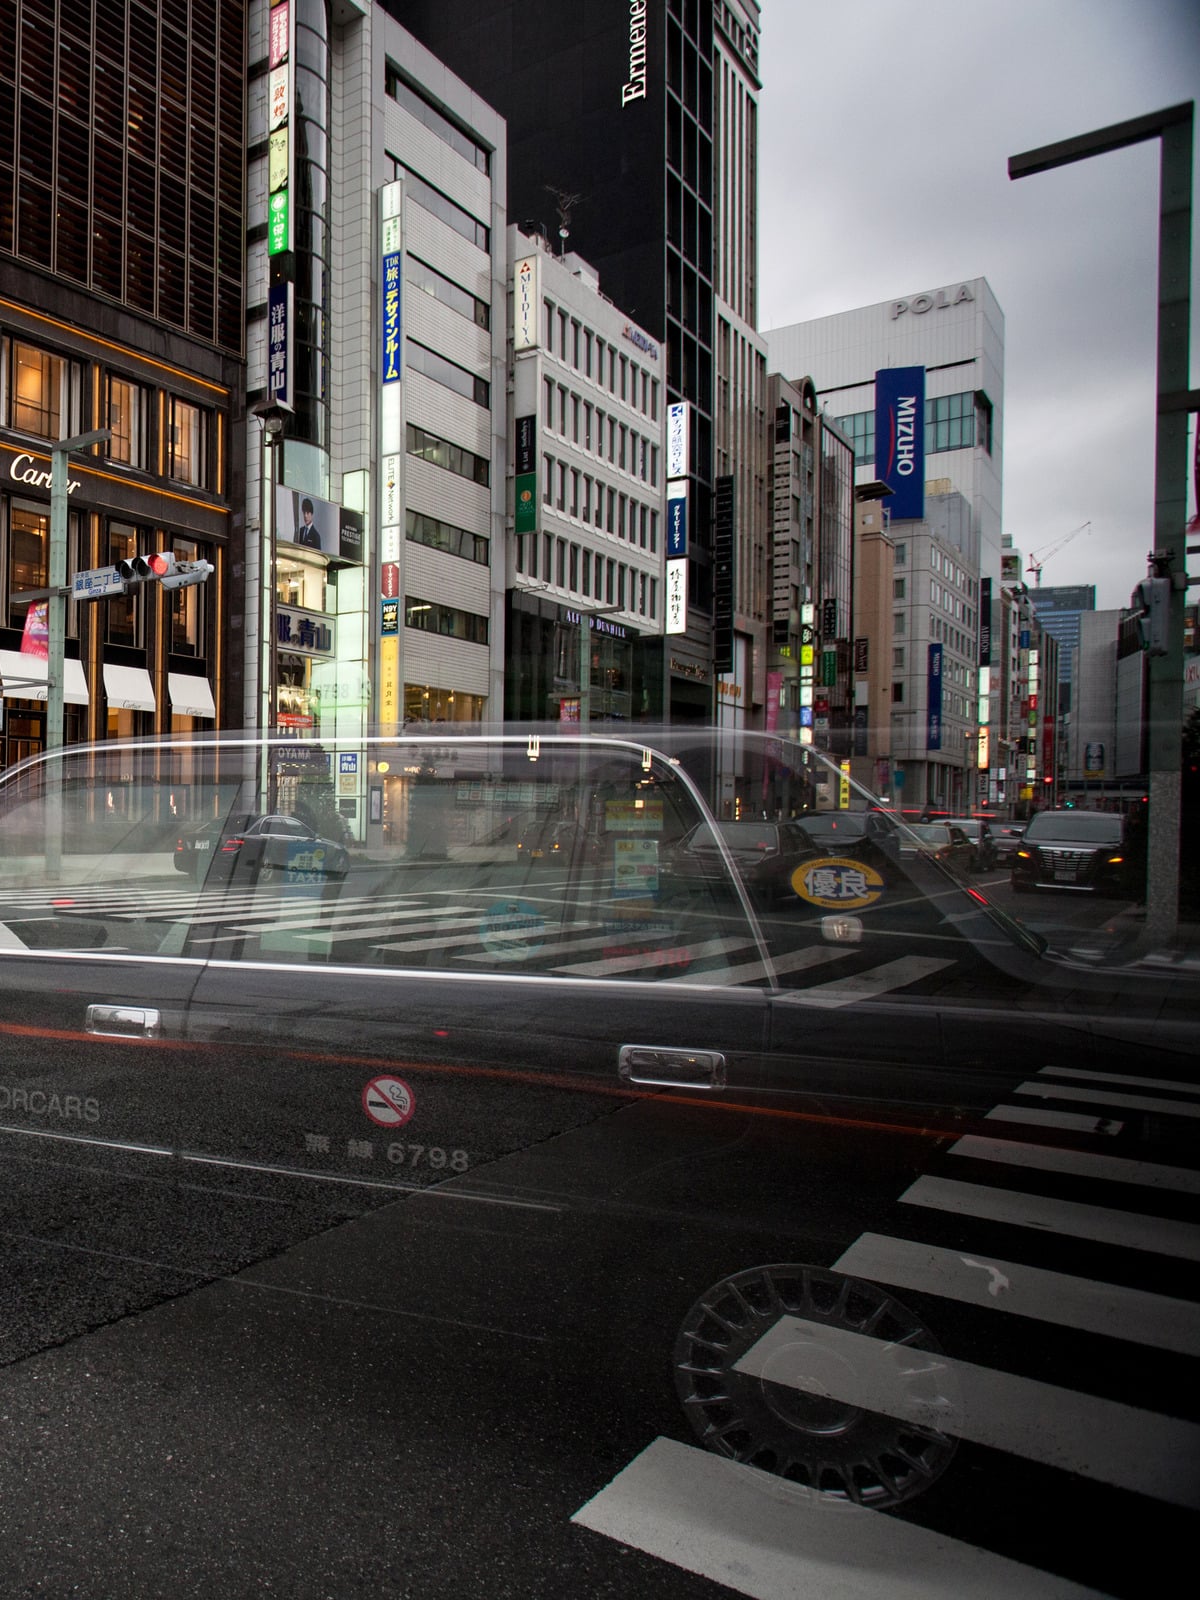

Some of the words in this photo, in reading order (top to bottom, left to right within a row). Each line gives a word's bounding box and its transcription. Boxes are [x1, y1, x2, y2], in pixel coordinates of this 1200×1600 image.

[622, 0, 647, 108] Ermene
[891, 285, 974, 320] POLA
[385, 266, 399, 379] 旅のデザインルーム
[270, 303, 286, 391] 洋服の青山
[896, 396, 917, 477] MIZUHO
[10, 453, 81, 495] Cartr
[75, 572, 121, 592] 銀座二丁目
[87, 587, 102, 595] Ginza
[596, 619, 626, 639] DUNHILL
[122, 700, 142, 711] Cartier
[185, 707, 204, 717] Cartier
[288, 872, 322, 883] TAXI
[804, 867, 869, 899] 優良
[387, 1141, 469, 1173] 6798
